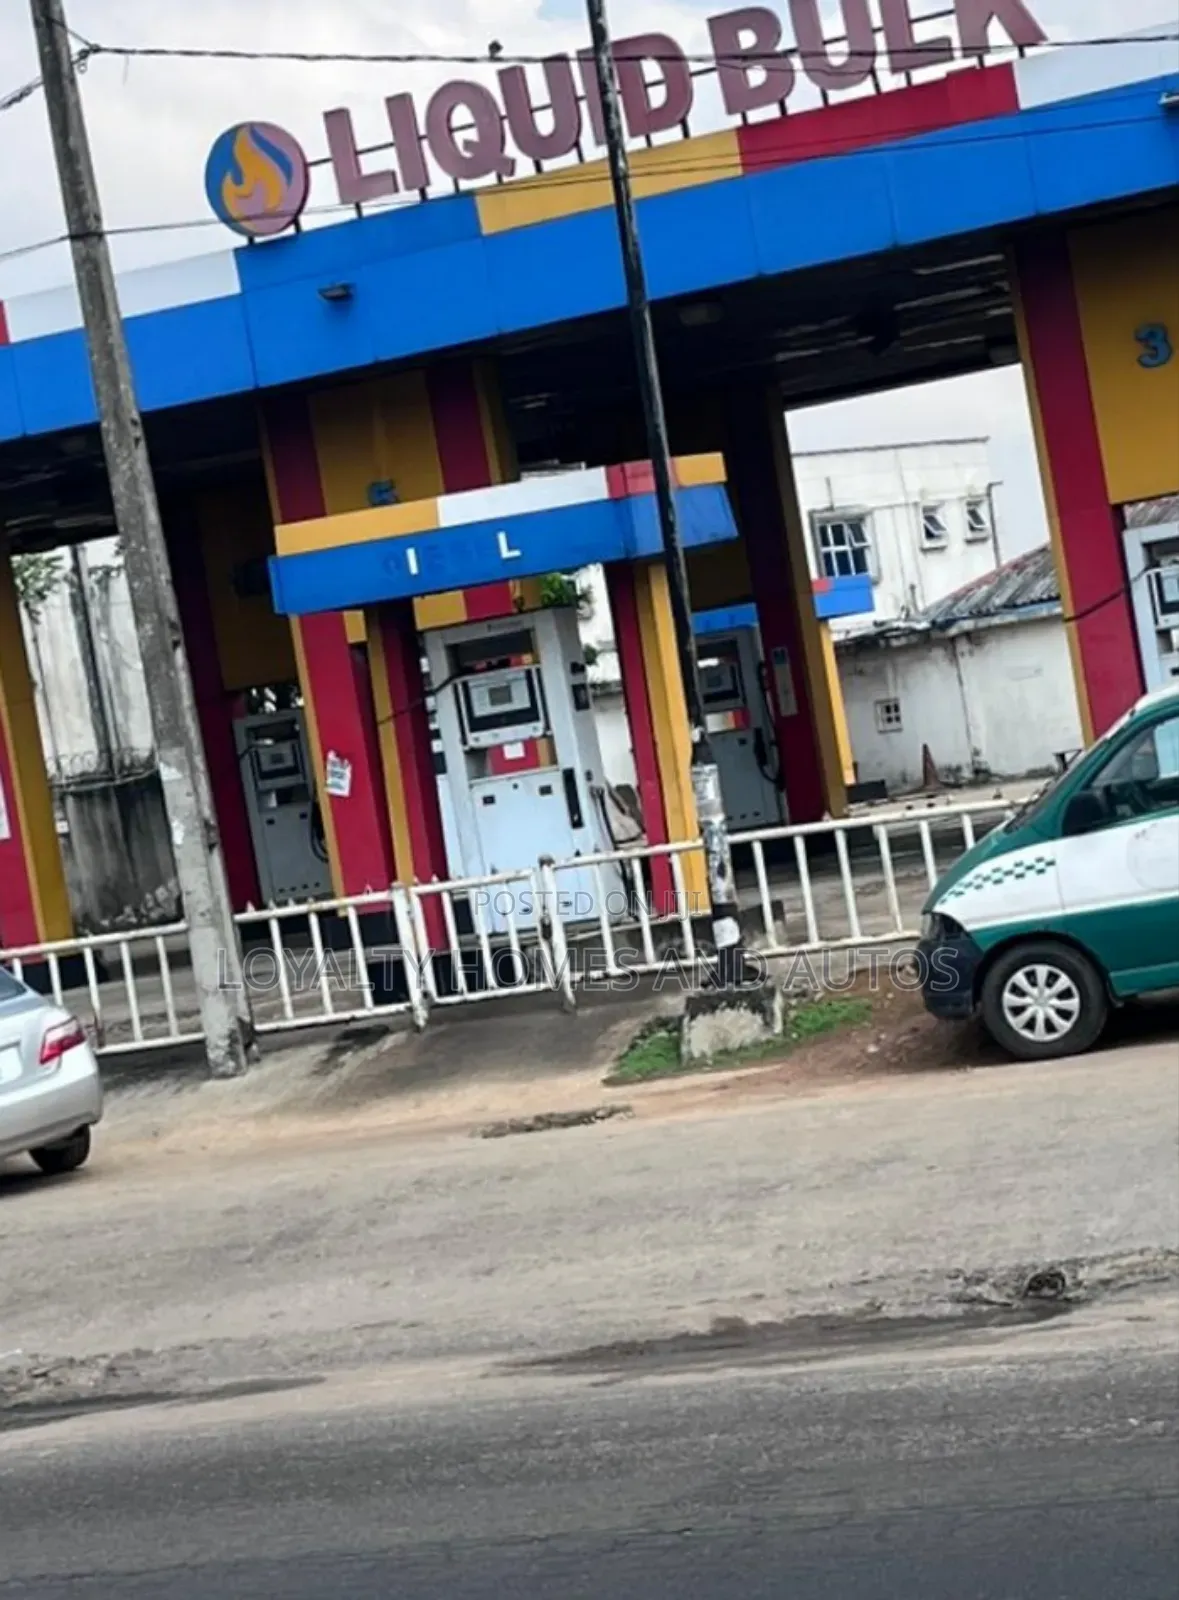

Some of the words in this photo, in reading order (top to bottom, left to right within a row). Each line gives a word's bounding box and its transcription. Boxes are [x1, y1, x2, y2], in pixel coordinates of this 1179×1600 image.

[323, 32, 694, 205] LIQUID
[707, 0, 1048, 116] BULK
[1133, 322, 1173, 369] 3
